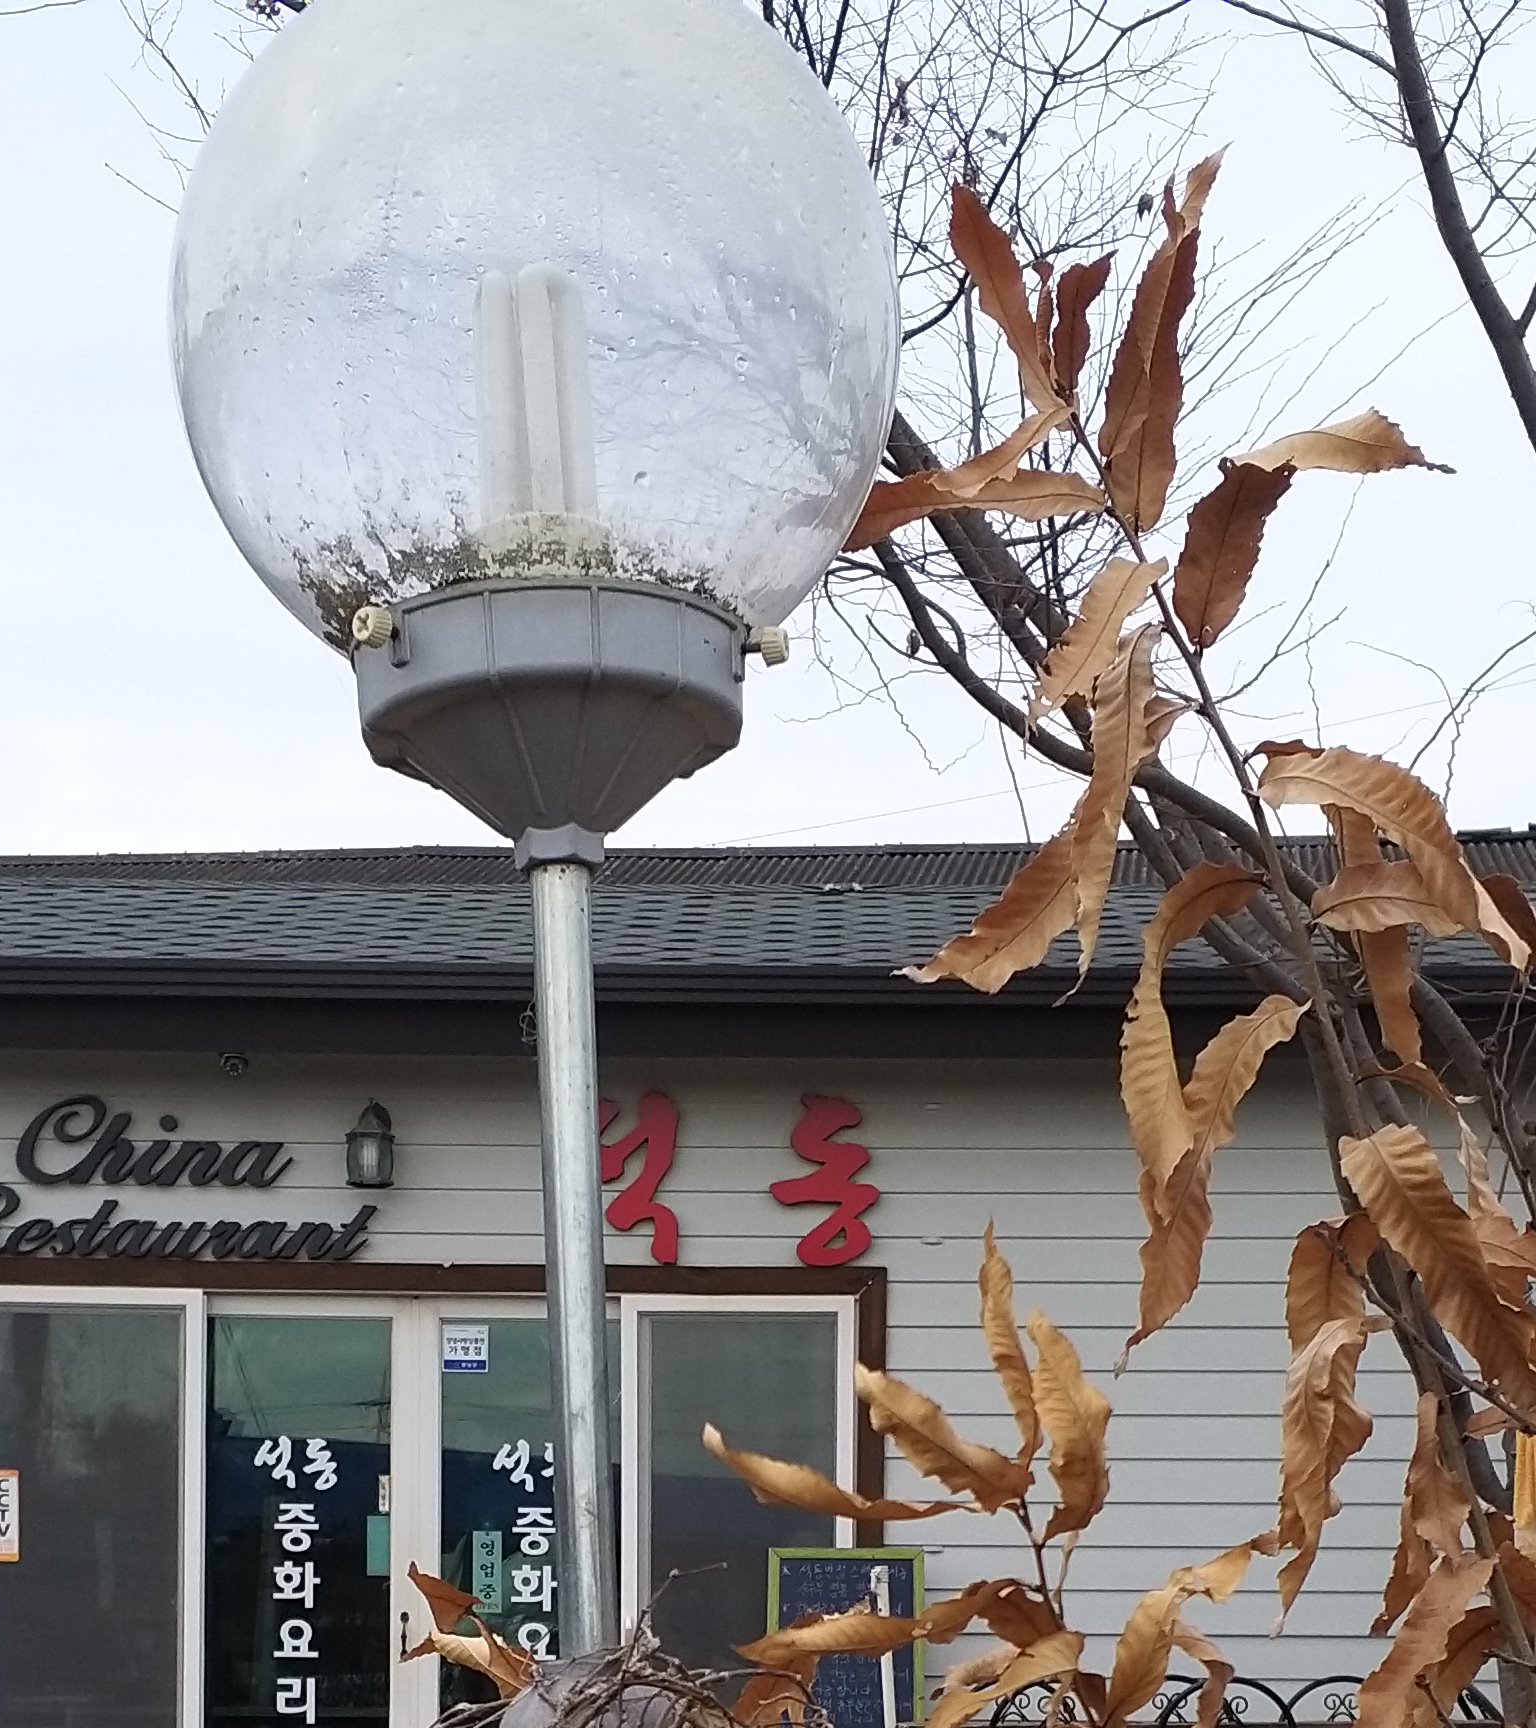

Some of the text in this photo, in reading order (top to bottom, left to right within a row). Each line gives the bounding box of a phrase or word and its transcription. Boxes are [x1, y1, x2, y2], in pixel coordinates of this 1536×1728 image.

[16, 1094, 293, 1188] China
[254, 1436, 338, 1490] 석동
[480, 1540, 497, 1599] 영업중
[272, 1503, 321, 1725] 중화요리
